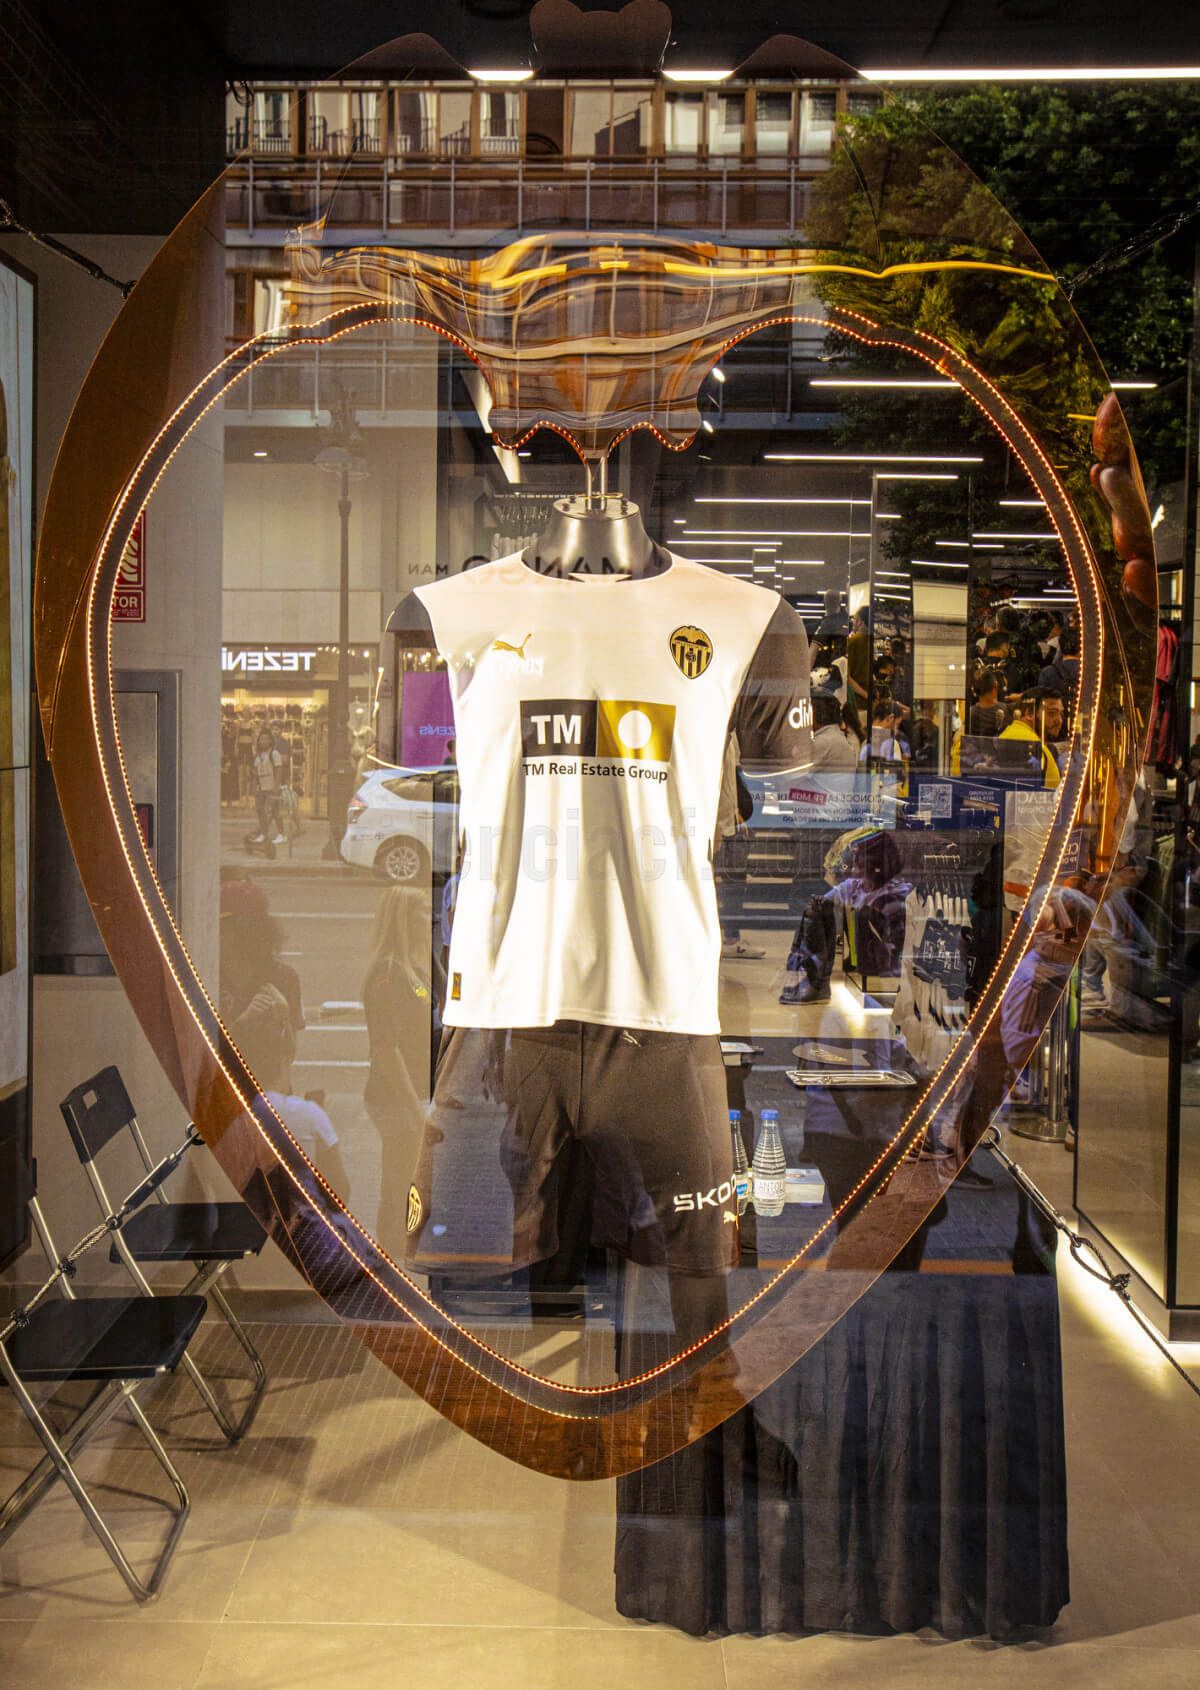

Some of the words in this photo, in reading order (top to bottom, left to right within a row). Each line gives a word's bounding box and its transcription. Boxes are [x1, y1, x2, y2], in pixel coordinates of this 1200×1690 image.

[530, 714, 582, 746] TM
[522, 763, 544, 776] TM
[549, 762, 578, 775] Real
[581, 763, 625, 777] Estate
[628, 765, 669, 784] Group
